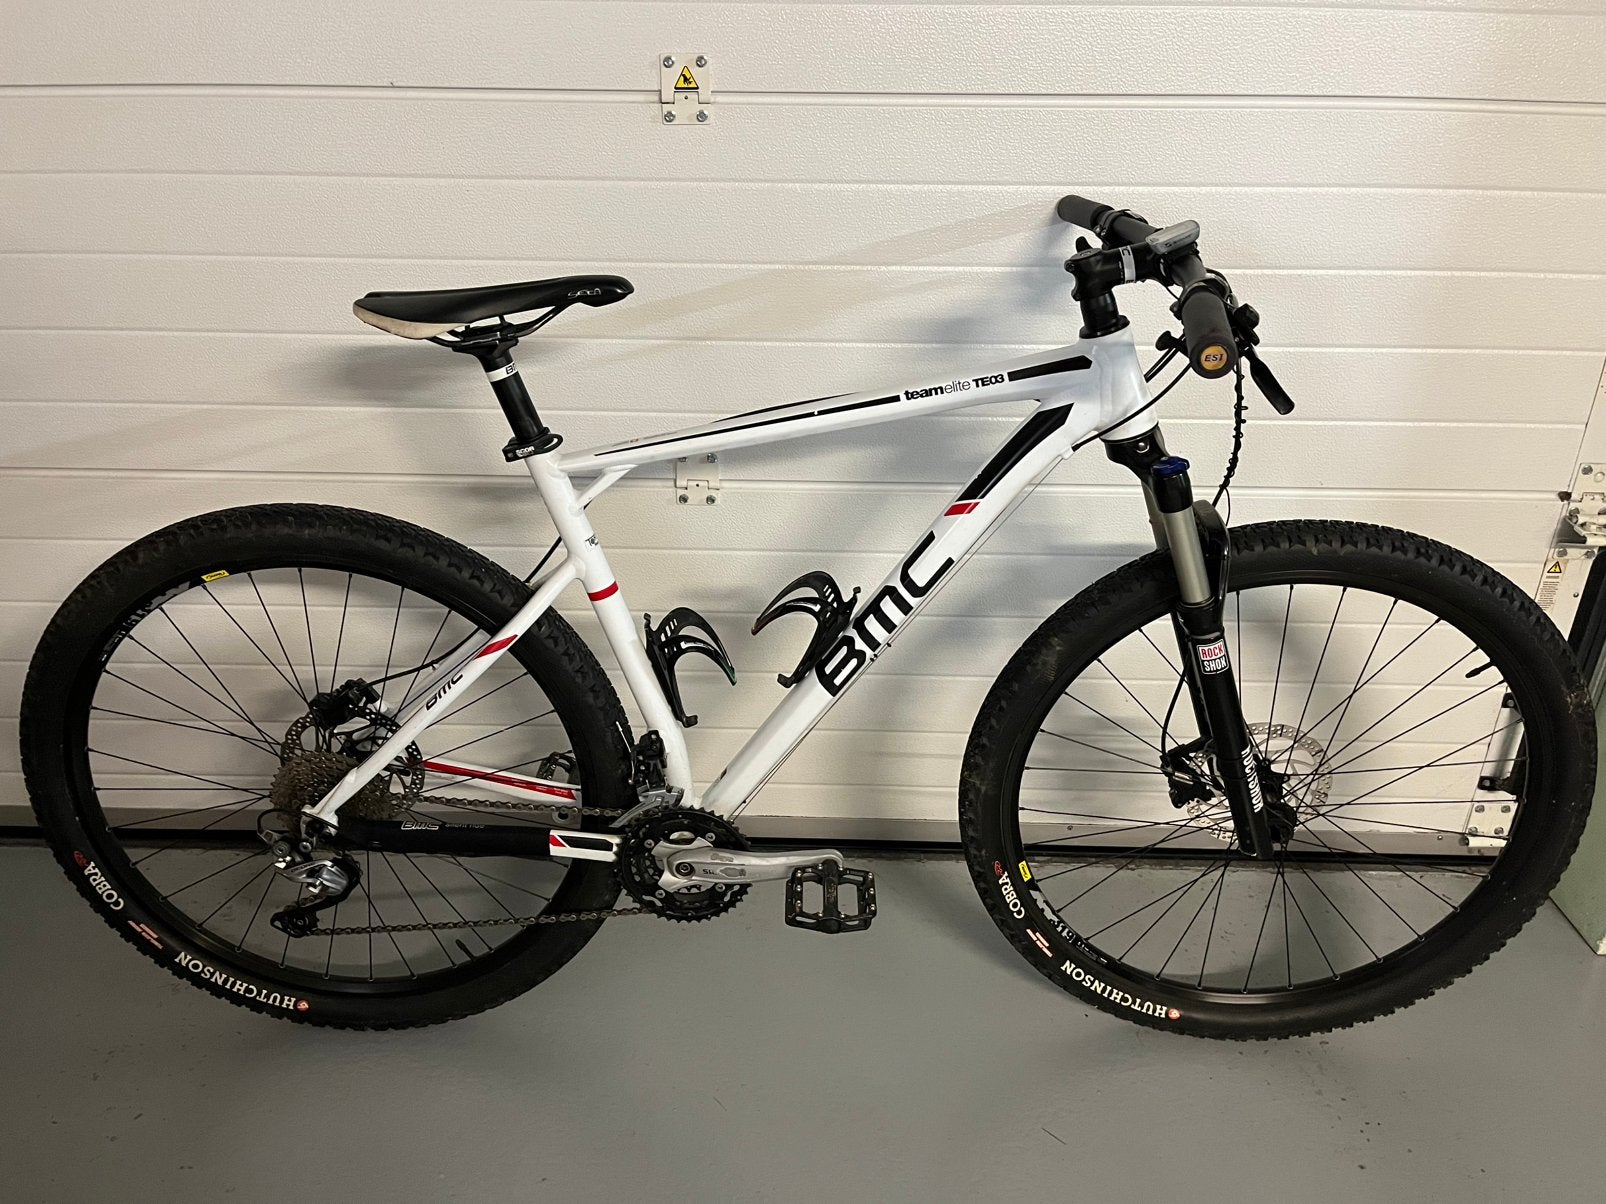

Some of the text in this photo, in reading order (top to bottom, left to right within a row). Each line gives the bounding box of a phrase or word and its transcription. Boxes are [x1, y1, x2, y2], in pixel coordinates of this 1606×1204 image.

[971, 373, 1006, 388] TE03
[1204, 353, 1224, 363] ESI
[814, 529, 956, 698] BMC
[1200, 643, 1224, 659] ROCK
[1203, 656, 1227, 672] SHOX
[83, 861, 125, 911] COBRA
[998, 870, 1026, 919] COBRA
[174, 951, 297, 1010] HUTCHINSON
[1060, 959, 1168, 1018] HUTCHINSON
